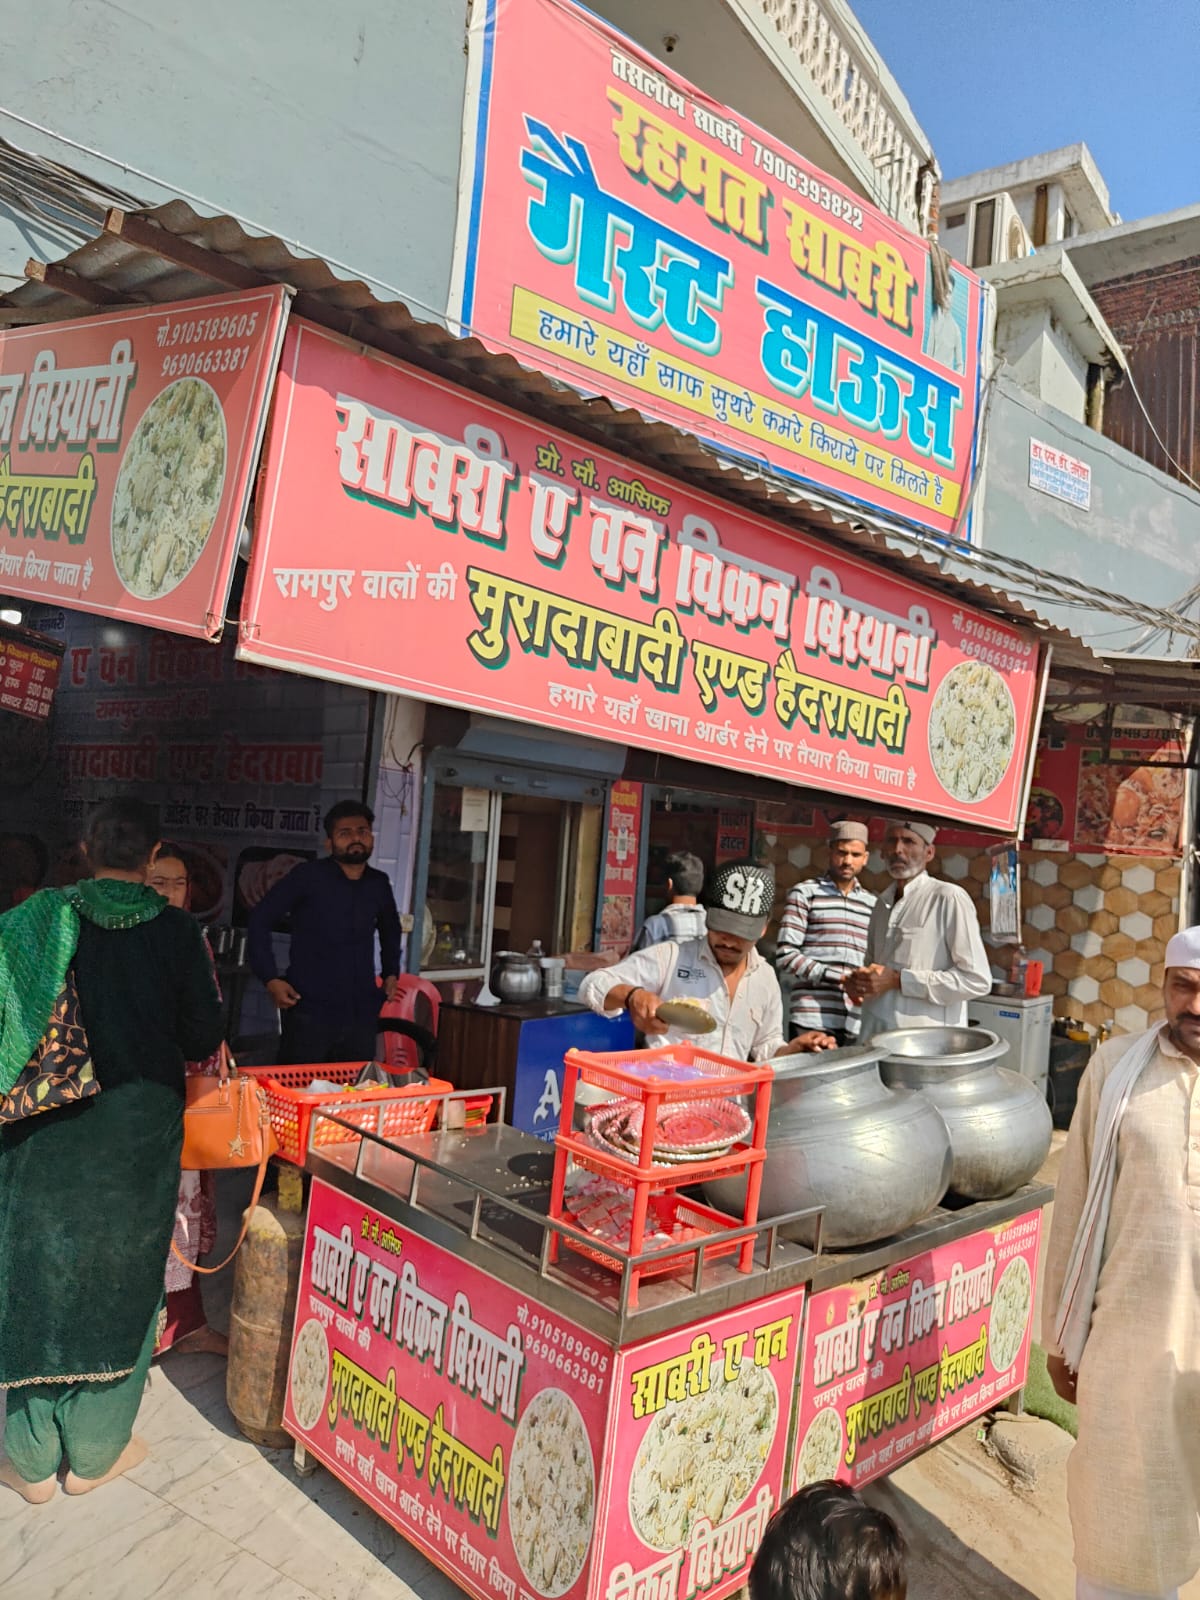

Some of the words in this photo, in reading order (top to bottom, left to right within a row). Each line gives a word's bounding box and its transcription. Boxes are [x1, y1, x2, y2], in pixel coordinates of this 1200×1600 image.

[605, 85, 769, 249] रहमत
[782, 194, 916, 328] साबरी
[691, 102, 745, 156] साबरी
[751, 138, 865, 232] 7906393822
[520, 112, 733, 355] गैस्ट
[755, 276, 964, 468] हाऊस
[19, 338, 138, 448] बिरयानी
[160, 346, 250, 377] 9690663381
[537, 309, 599, 356] हमारे
[607, 342, 649, 379] यहाँ
[656, 365, 705, 399] साफ
[711, 384, 756, 425] सुथरे
[762, 403, 804, 443] कमरे
[810, 421, 860, 467] किराये
[864, 452, 886, 478] पर
[890, 458, 930, 499] मिलते
[932, 474, 945, 506] है
[335, 393, 515, 547] साबरी
[528, 471, 578, 566] ए
[588, 496, 667, 598] वन
[676, 514, 799, 638] चिकन
[804, 565, 936, 687] बिरयानी
[607, 473, 671, 516] आसिफ
[23, 549, 52, 582] किया
[53, 562, 82, 588] जाता
[82, 557, 94, 591] है
[273, 567, 356, 612] रामपुर
[362, 561, 421, 601] वालों
[426, 561, 458, 601] की
[467, 564, 686, 689] मुरादाबादी
[691, 637, 769, 715] एण्ड
[773, 648, 911, 755] हैदराबादी
[547, 681, 597, 713] हमारे
[603, 691, 640, 725] यहाँ
[643, 706, 689, 738] खाना
[743, 727, 770, 755] देने
[773, 738, 794, 760] पर
[796, 739, 834, 771] तैयार
[836, 748, 870, 781] किया
[872, 762, 905, 790] जाता
[905, 768, 918, 791] है
[311, 1224, 354, 1308] साबरी
[352, 1251, 371, 1320] ए
[369, 1260, 398, 1340] वन
[395, 1261, 449, 1376] चिकन
[446, 1292, 525, 1427] बिरयानी
[525, 1334, 605, 1395] 9690663381
[631, 1333, 717, 1419] साबरी
[722, 1332, 749, 1383] ए
[754, 1316, 793, 1370] वन
[813, 1309, 862, 1388] साबरी
[863, 1310, 881, 1364] ए
[881, 1298, 909, 1353] वन
[908, 1279, 948, 1345] चिकन
[946, 1248, 997, 1326] बिरयानी
[327, 1348, 397, 1450] मुरादाबादी
[396, 1397, 431, 1478] एण्ड
[429, 1402, 505, 1540] हैदराबादी
[813, 1380, 844, 1408] रामपुर
[845, 1363, 912, 1465] मुरादाबादी
[912, 1361, 940, 1419] एण्ड
[938, 1324, 989, 1402] हैदराबादी
[855, 1450, 877, 1479] हमारे
[950, 1402, 961, 1420] पर
[1009, 1365, 1018, 1386] है
[335, 1435, 357, 1468] हमारे
[375, 1467, 398, 1503] खाना
[443, 1524, 459, 1555] पर
[685, 1483, 774, 1600] बिरयानी
